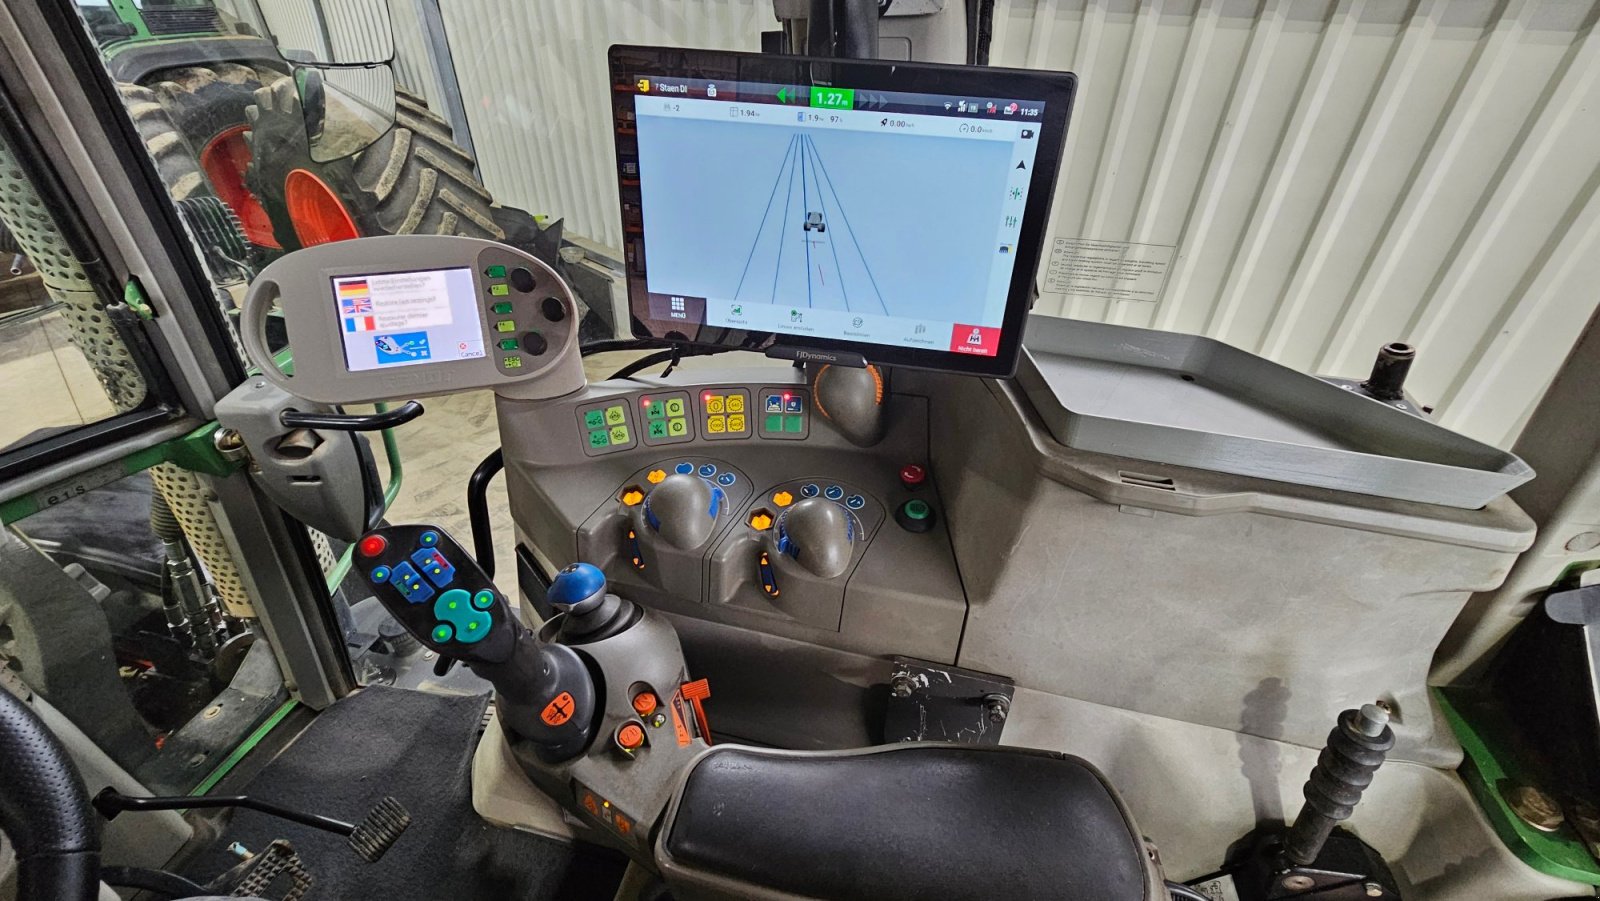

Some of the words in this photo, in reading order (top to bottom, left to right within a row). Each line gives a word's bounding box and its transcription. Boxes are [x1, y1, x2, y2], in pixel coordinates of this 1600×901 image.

[1020, 108, 1038, 116] 11:35
[460, 348, 483, 358] Cancel
[796, 350, 837, 362] FJDynamics
